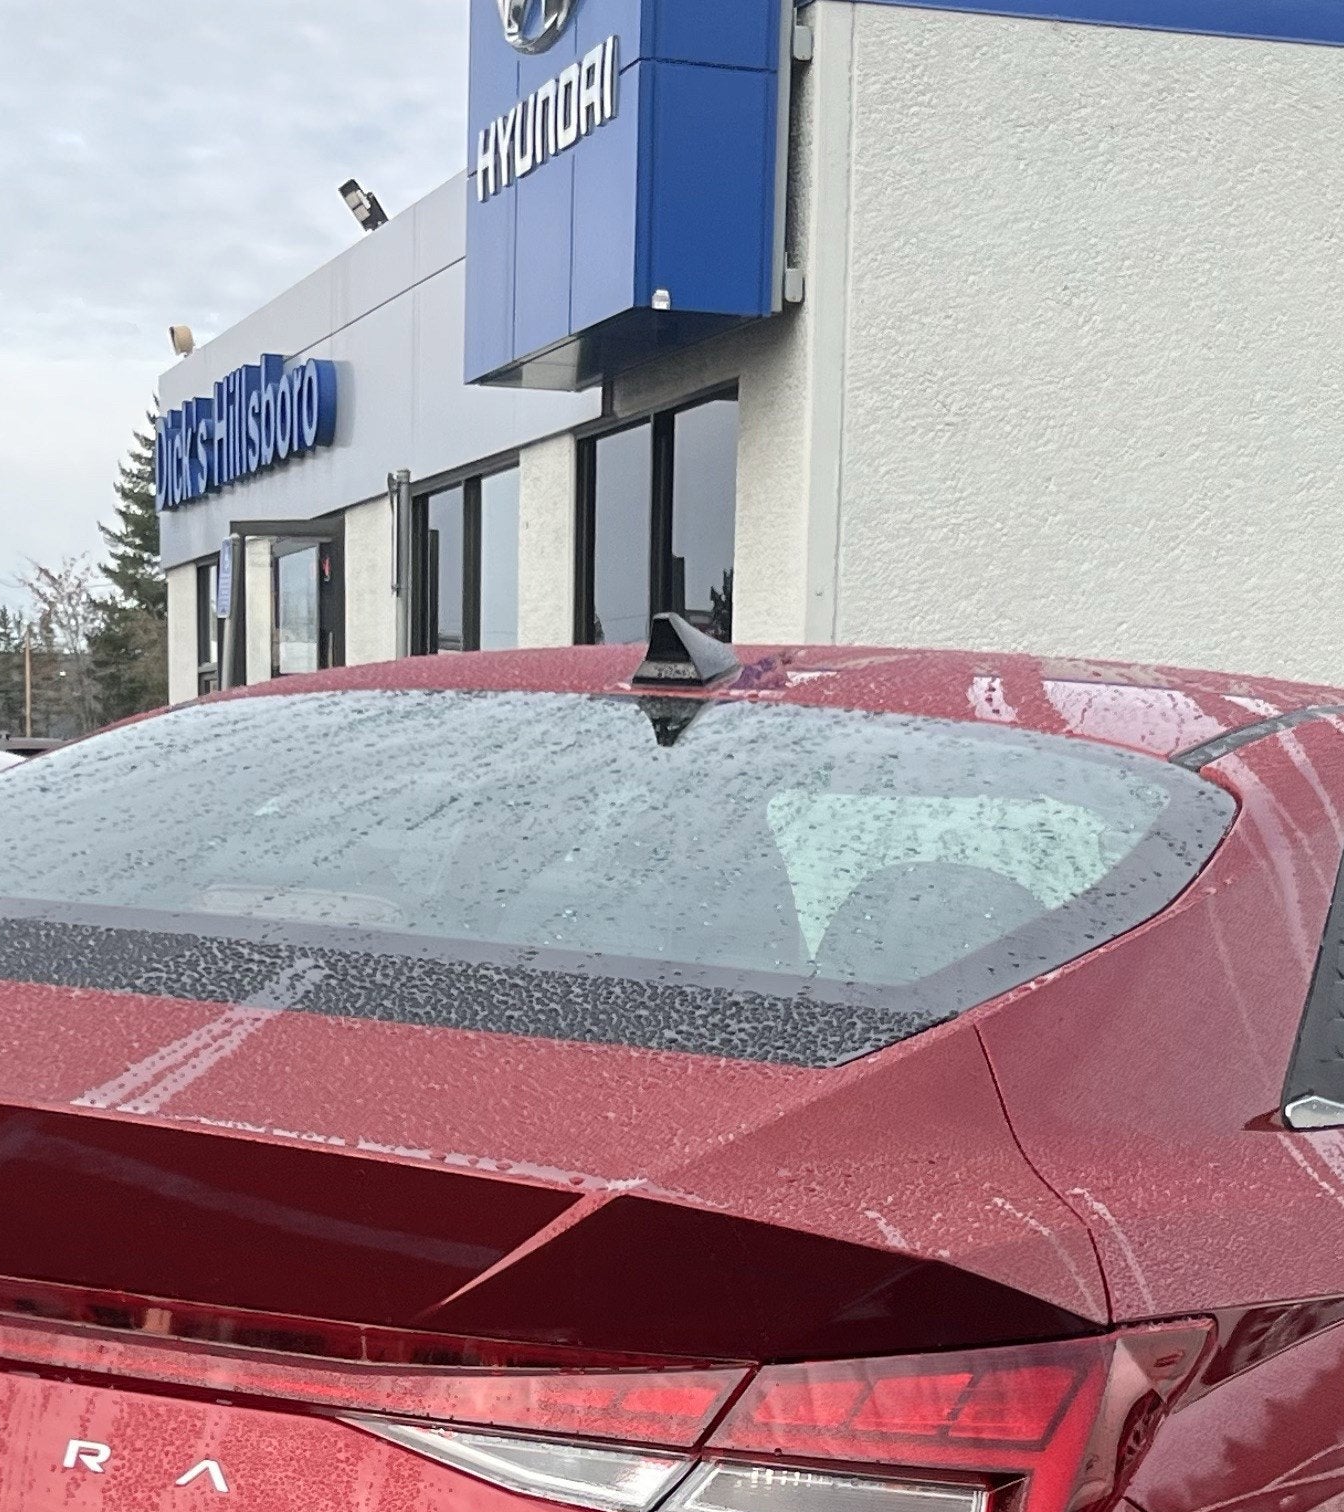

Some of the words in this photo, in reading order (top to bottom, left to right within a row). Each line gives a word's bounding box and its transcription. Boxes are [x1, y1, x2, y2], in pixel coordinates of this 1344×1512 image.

[477, 35, 619, 202] HYUNDAI
[155, 397, 209, 512] Dick's
[213, 354, 324, 486] Hillsboro
